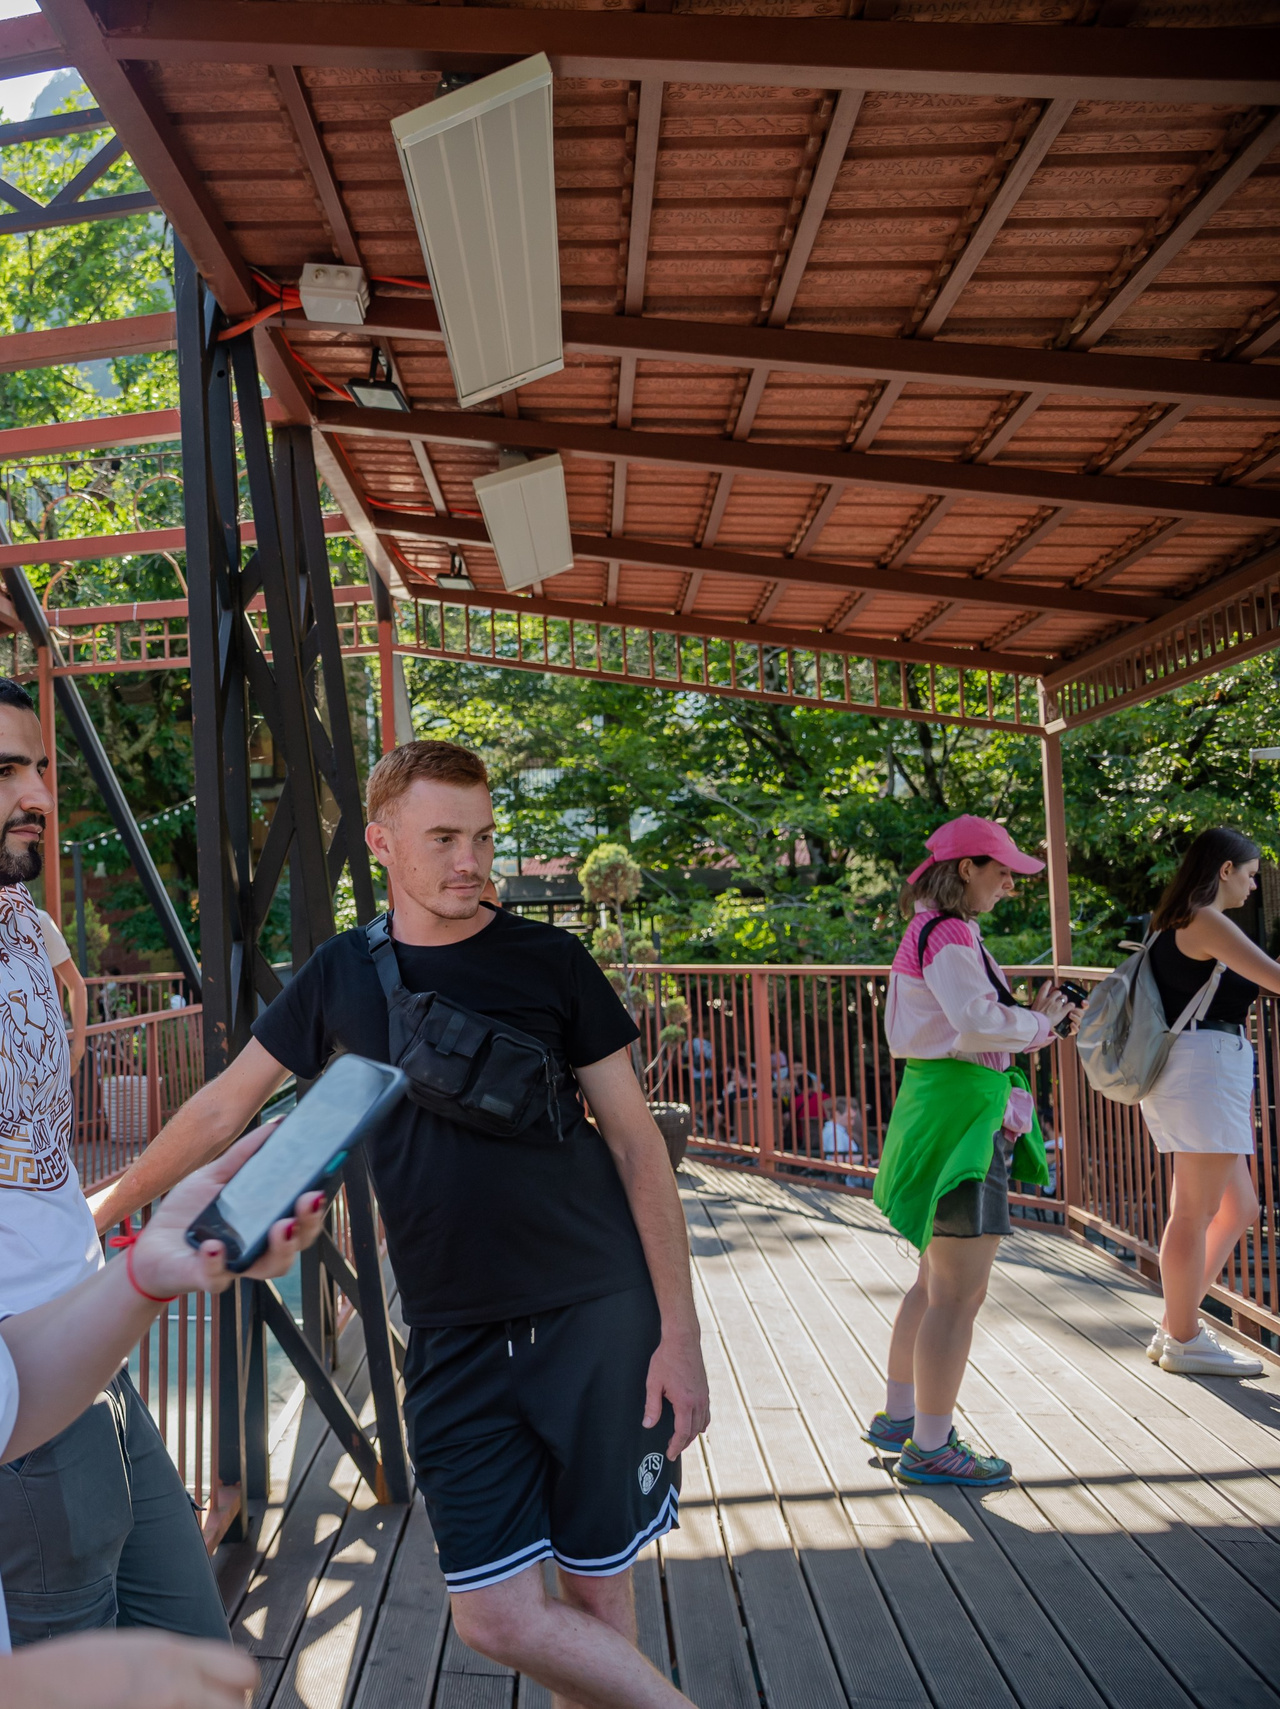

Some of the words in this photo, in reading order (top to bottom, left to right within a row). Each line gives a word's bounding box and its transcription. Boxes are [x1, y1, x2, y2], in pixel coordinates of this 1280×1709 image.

[698, 89, 778, 99] PFANNE
[895, 98, 979, 107] PFANNE
[1105, 104, 1194, 114] PFANNE
[841, 157, 984, 170] FRANKFURTER
[1034, 167, 1183, 178] FRANKFURTER
[639, 1454, 660, 1477] NETS
